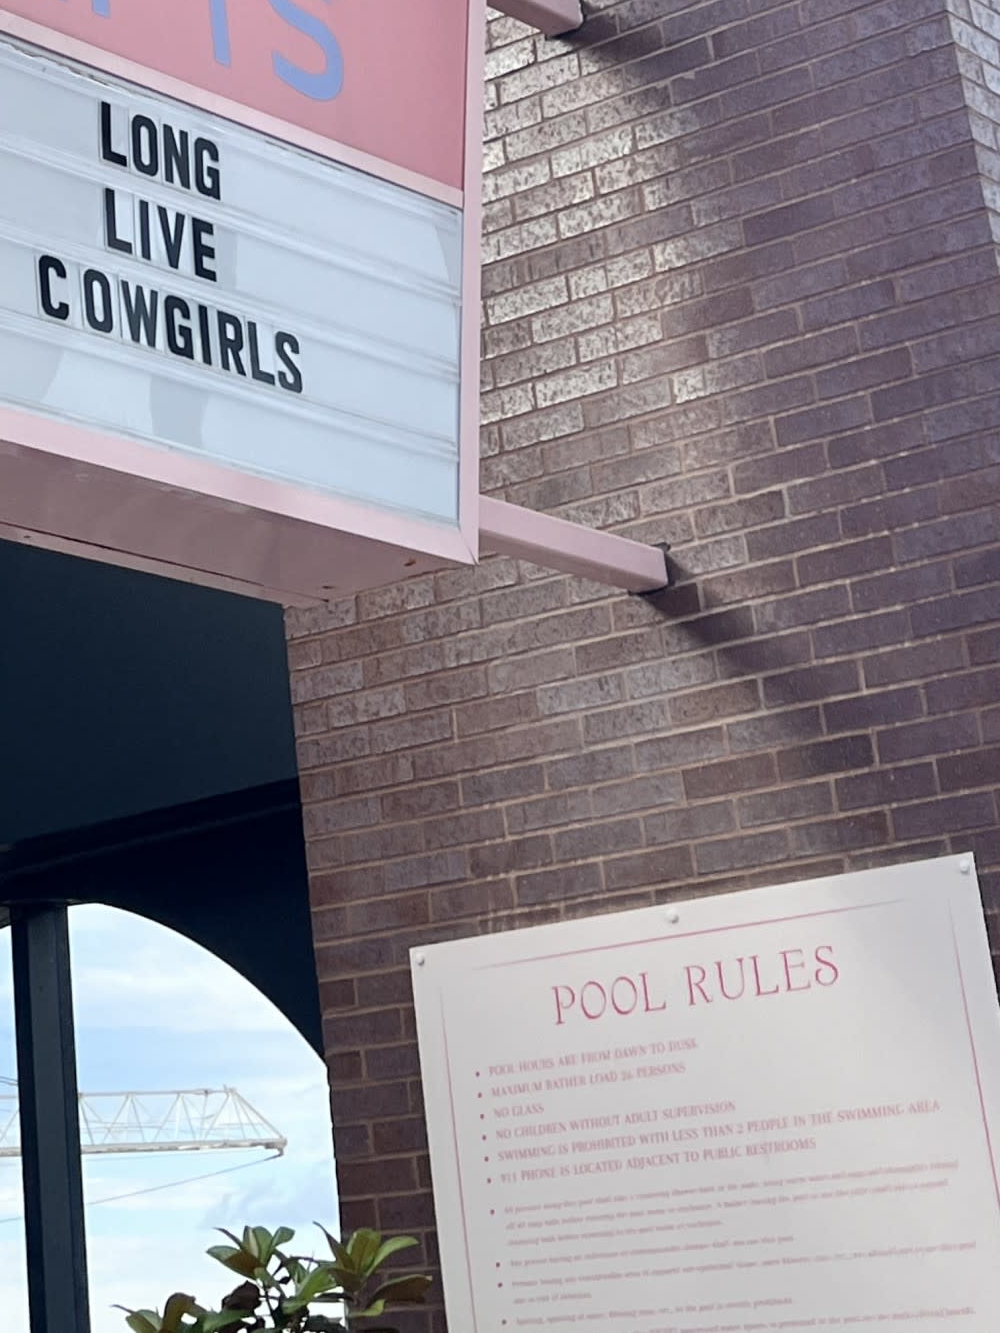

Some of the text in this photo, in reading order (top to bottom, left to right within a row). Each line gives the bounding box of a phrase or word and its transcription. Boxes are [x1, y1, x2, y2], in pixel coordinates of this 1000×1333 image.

[101, 100, 221, 201] LONG
[104, 187, 217, 282] LIVE
[38, 254, 303, 394] COWGIRLS
[552, 945, 840, 1025] POOL RULES
[488, 1037, 698, 1077] POOL HOURS ARE FROM DAWN TO DUSK
[491, 1080, 543, 1098] MAXIMUM
[546, 1074, 587, 1091] BATHER
[589, 1069, 618, 1085] LOAD
[636, 1062, 686, 1079] PERSONS
[493, 1102, 545, 1119] NO GLASS
[496, 1100, 736, 1141] NO CHILDREN WITHOUT ADULT SUPERVISION
[497, 1098, 941, 1162] SWIMMING IS PROHIBITED WITH LESS THAN 2 PEOPLE IN THE SWIMMING AREA
[500, 1136, 816, 1184] 911 PHONE IS LOCATED ADJACENT TO PUBLIC RESTROOMS
